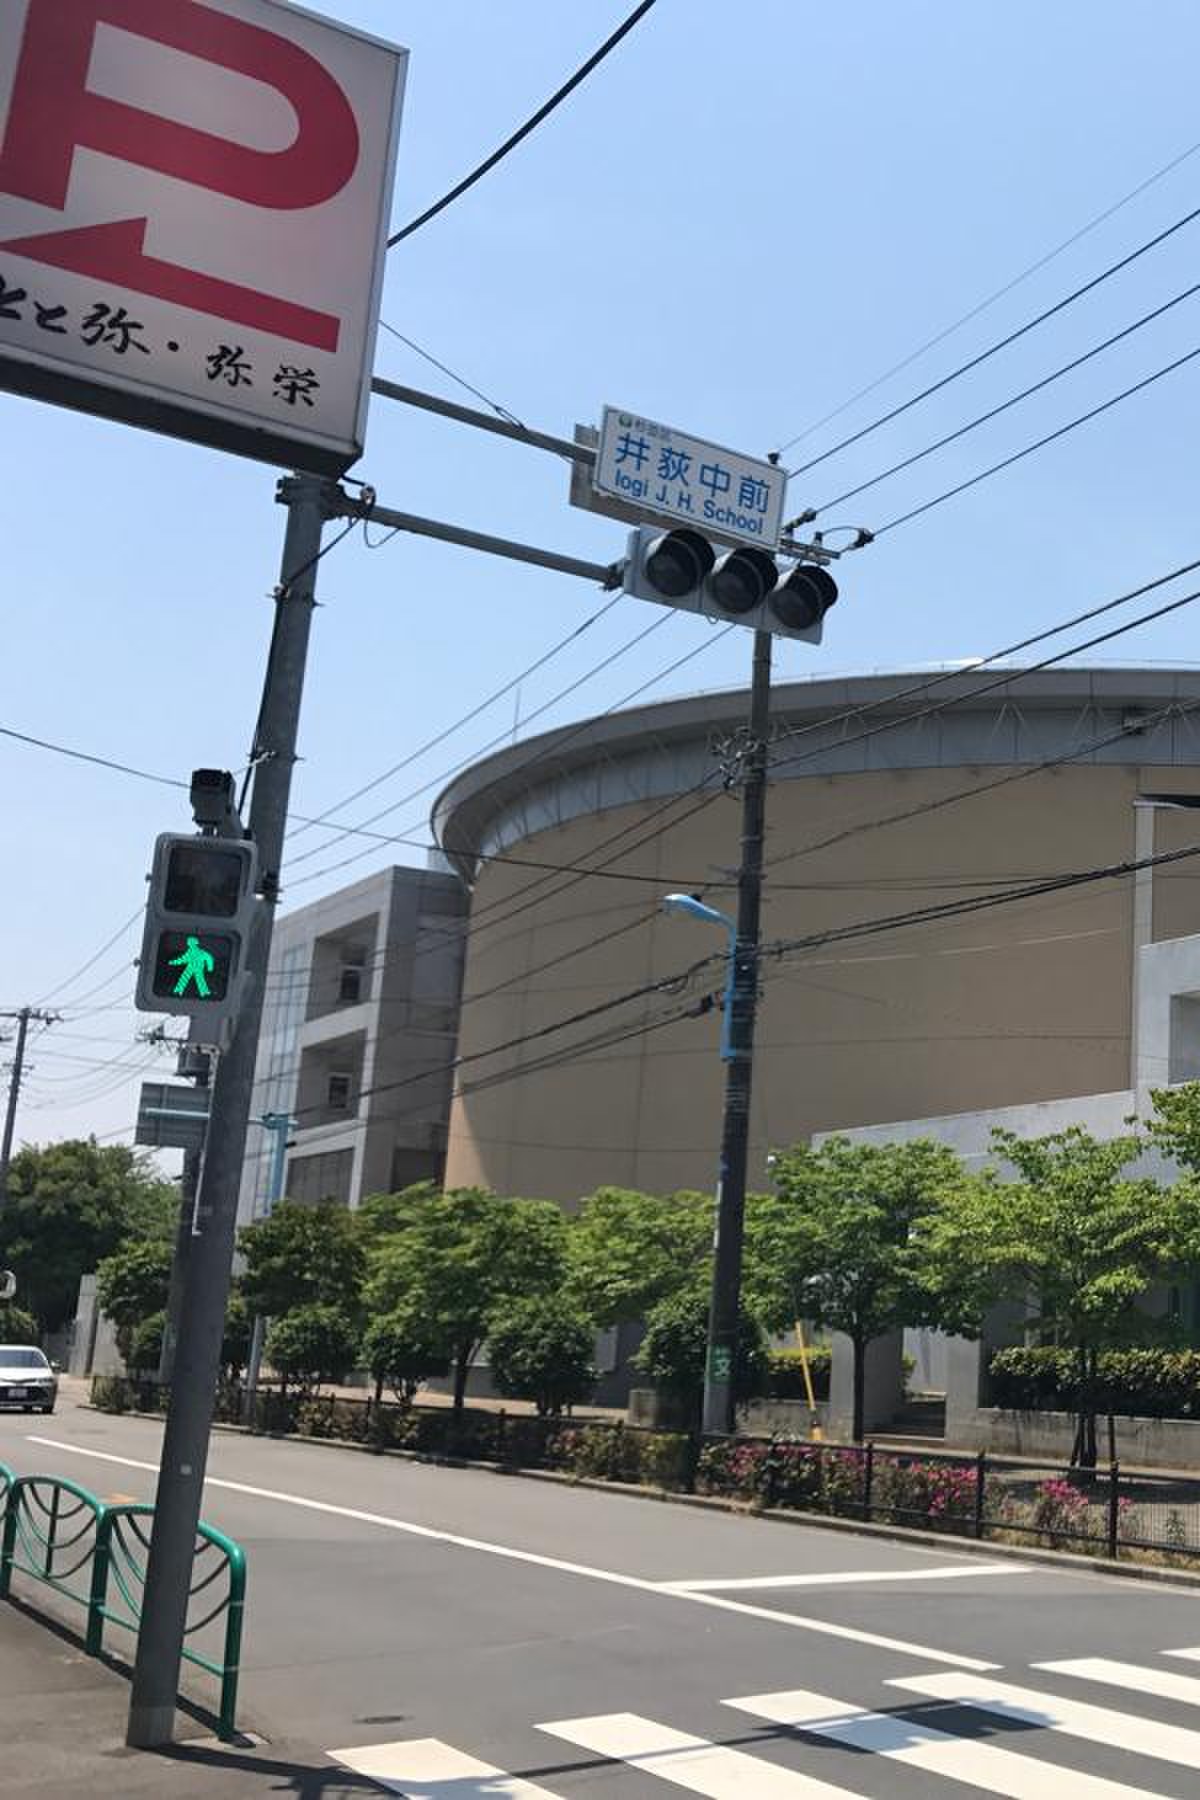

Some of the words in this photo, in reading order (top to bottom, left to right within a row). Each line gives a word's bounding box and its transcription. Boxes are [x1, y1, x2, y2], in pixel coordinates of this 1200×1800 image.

[0, 0, 359, 210] P
[615, 433, 770, 513] 井荻中前
[656, 485, 669, 505] J.
[677, 490, 694, 514] H.
[703, 499, 763, 535] School
